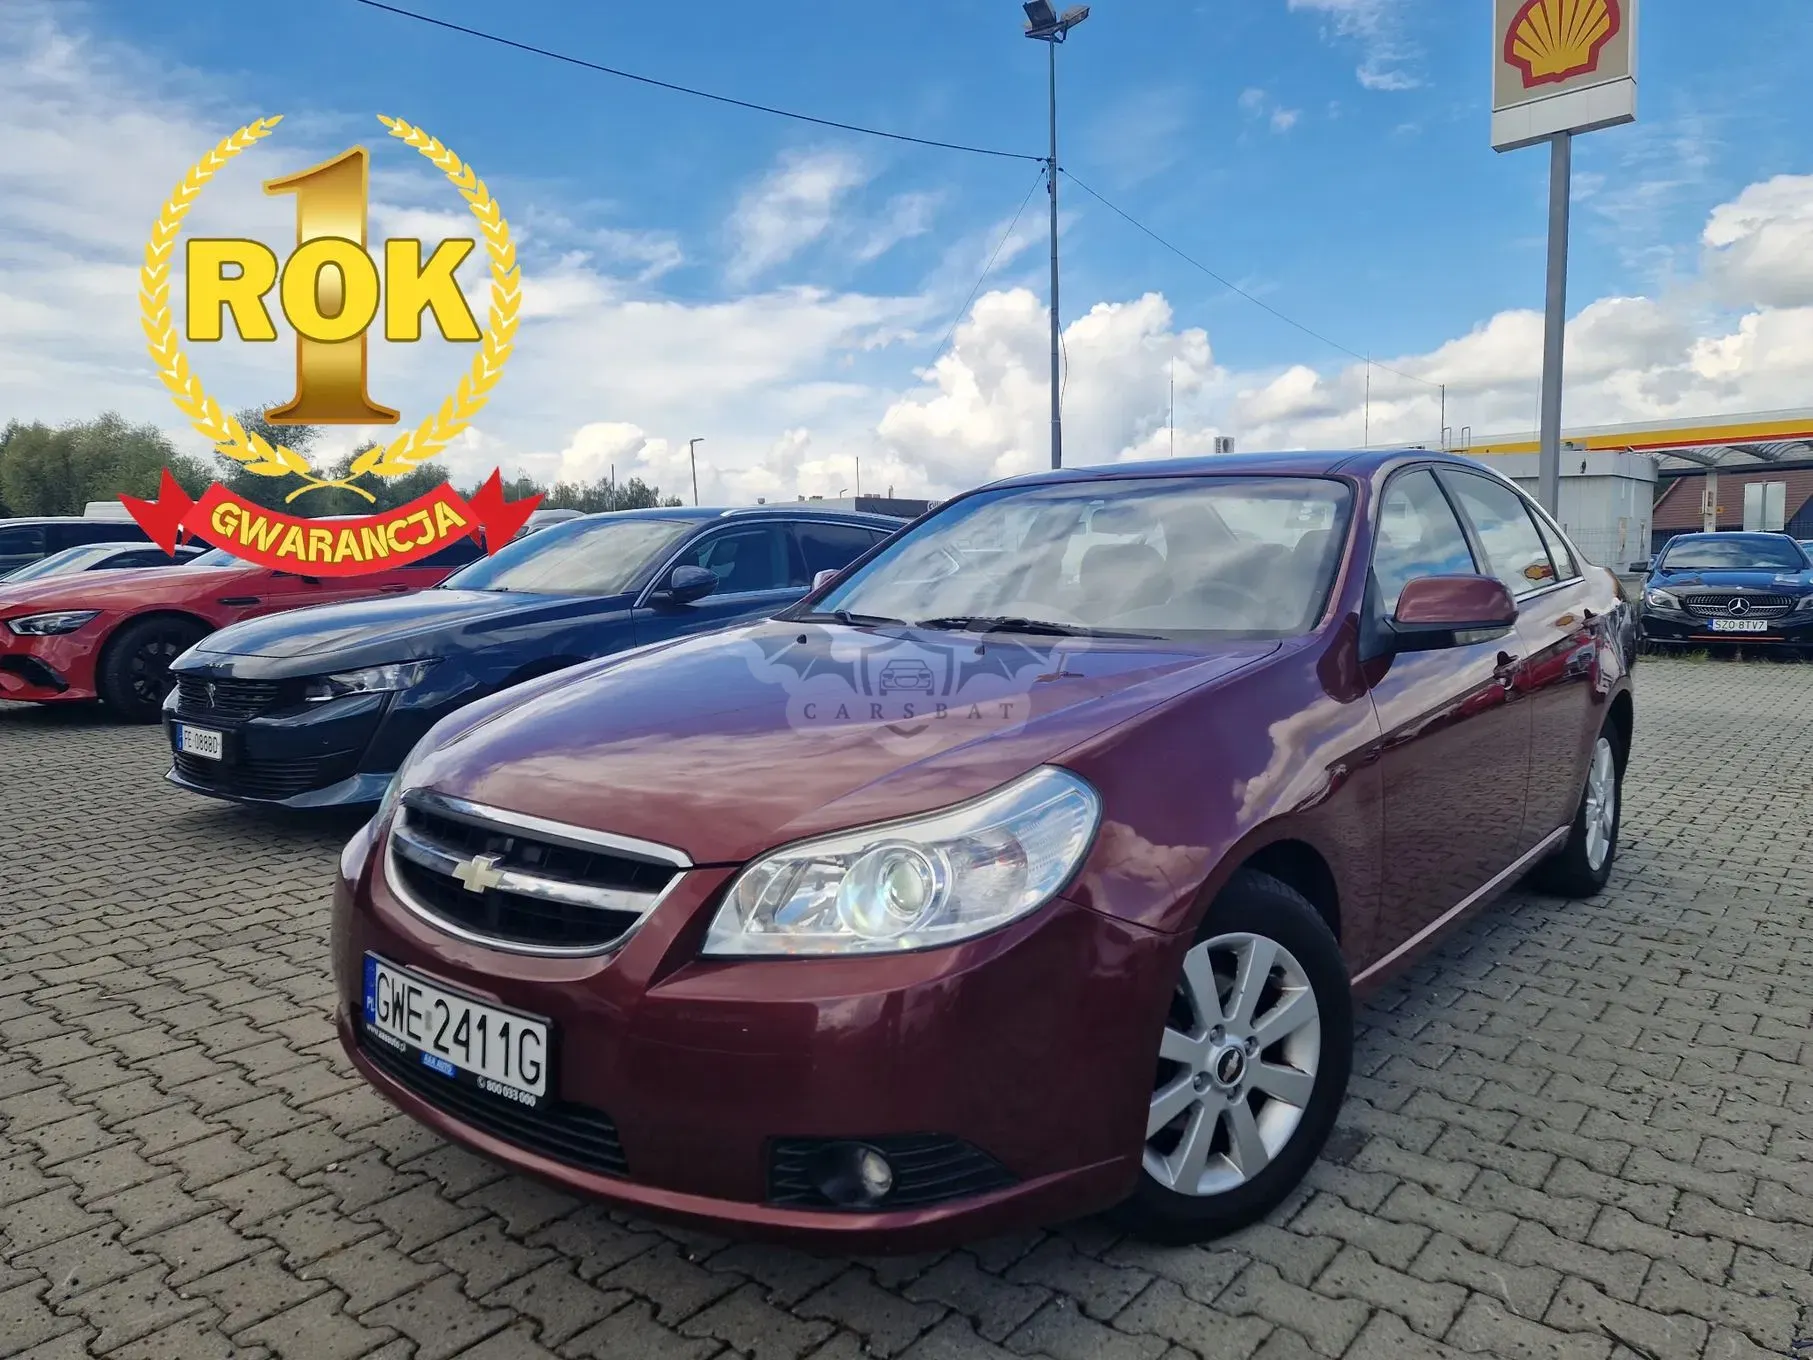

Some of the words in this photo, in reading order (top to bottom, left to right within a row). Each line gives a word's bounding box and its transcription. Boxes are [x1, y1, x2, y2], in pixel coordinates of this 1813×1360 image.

[1738, 620, 1765, 630] 8TV7
[366, 995, 375, 1012] PL
[377, 972, 422, 1042] GWE
[433, 998, 541, 1085] 2411G
